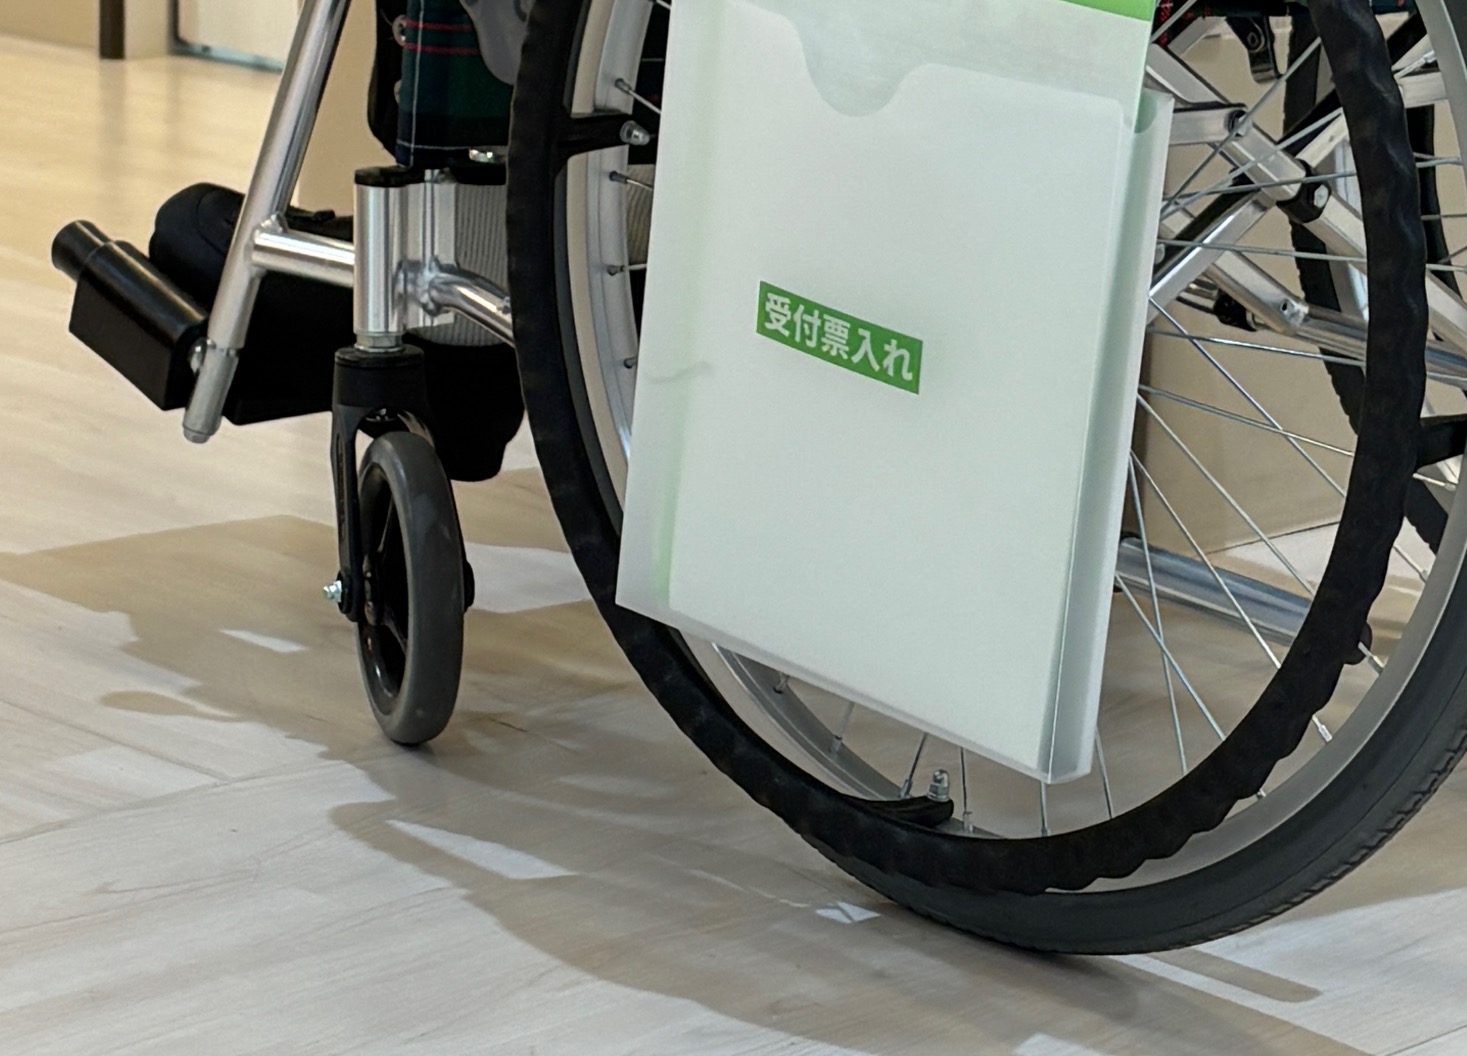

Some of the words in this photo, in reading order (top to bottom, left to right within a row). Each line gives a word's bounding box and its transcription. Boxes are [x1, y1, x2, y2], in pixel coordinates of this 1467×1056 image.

[764, 292, 913, 381] 受付票入れ
